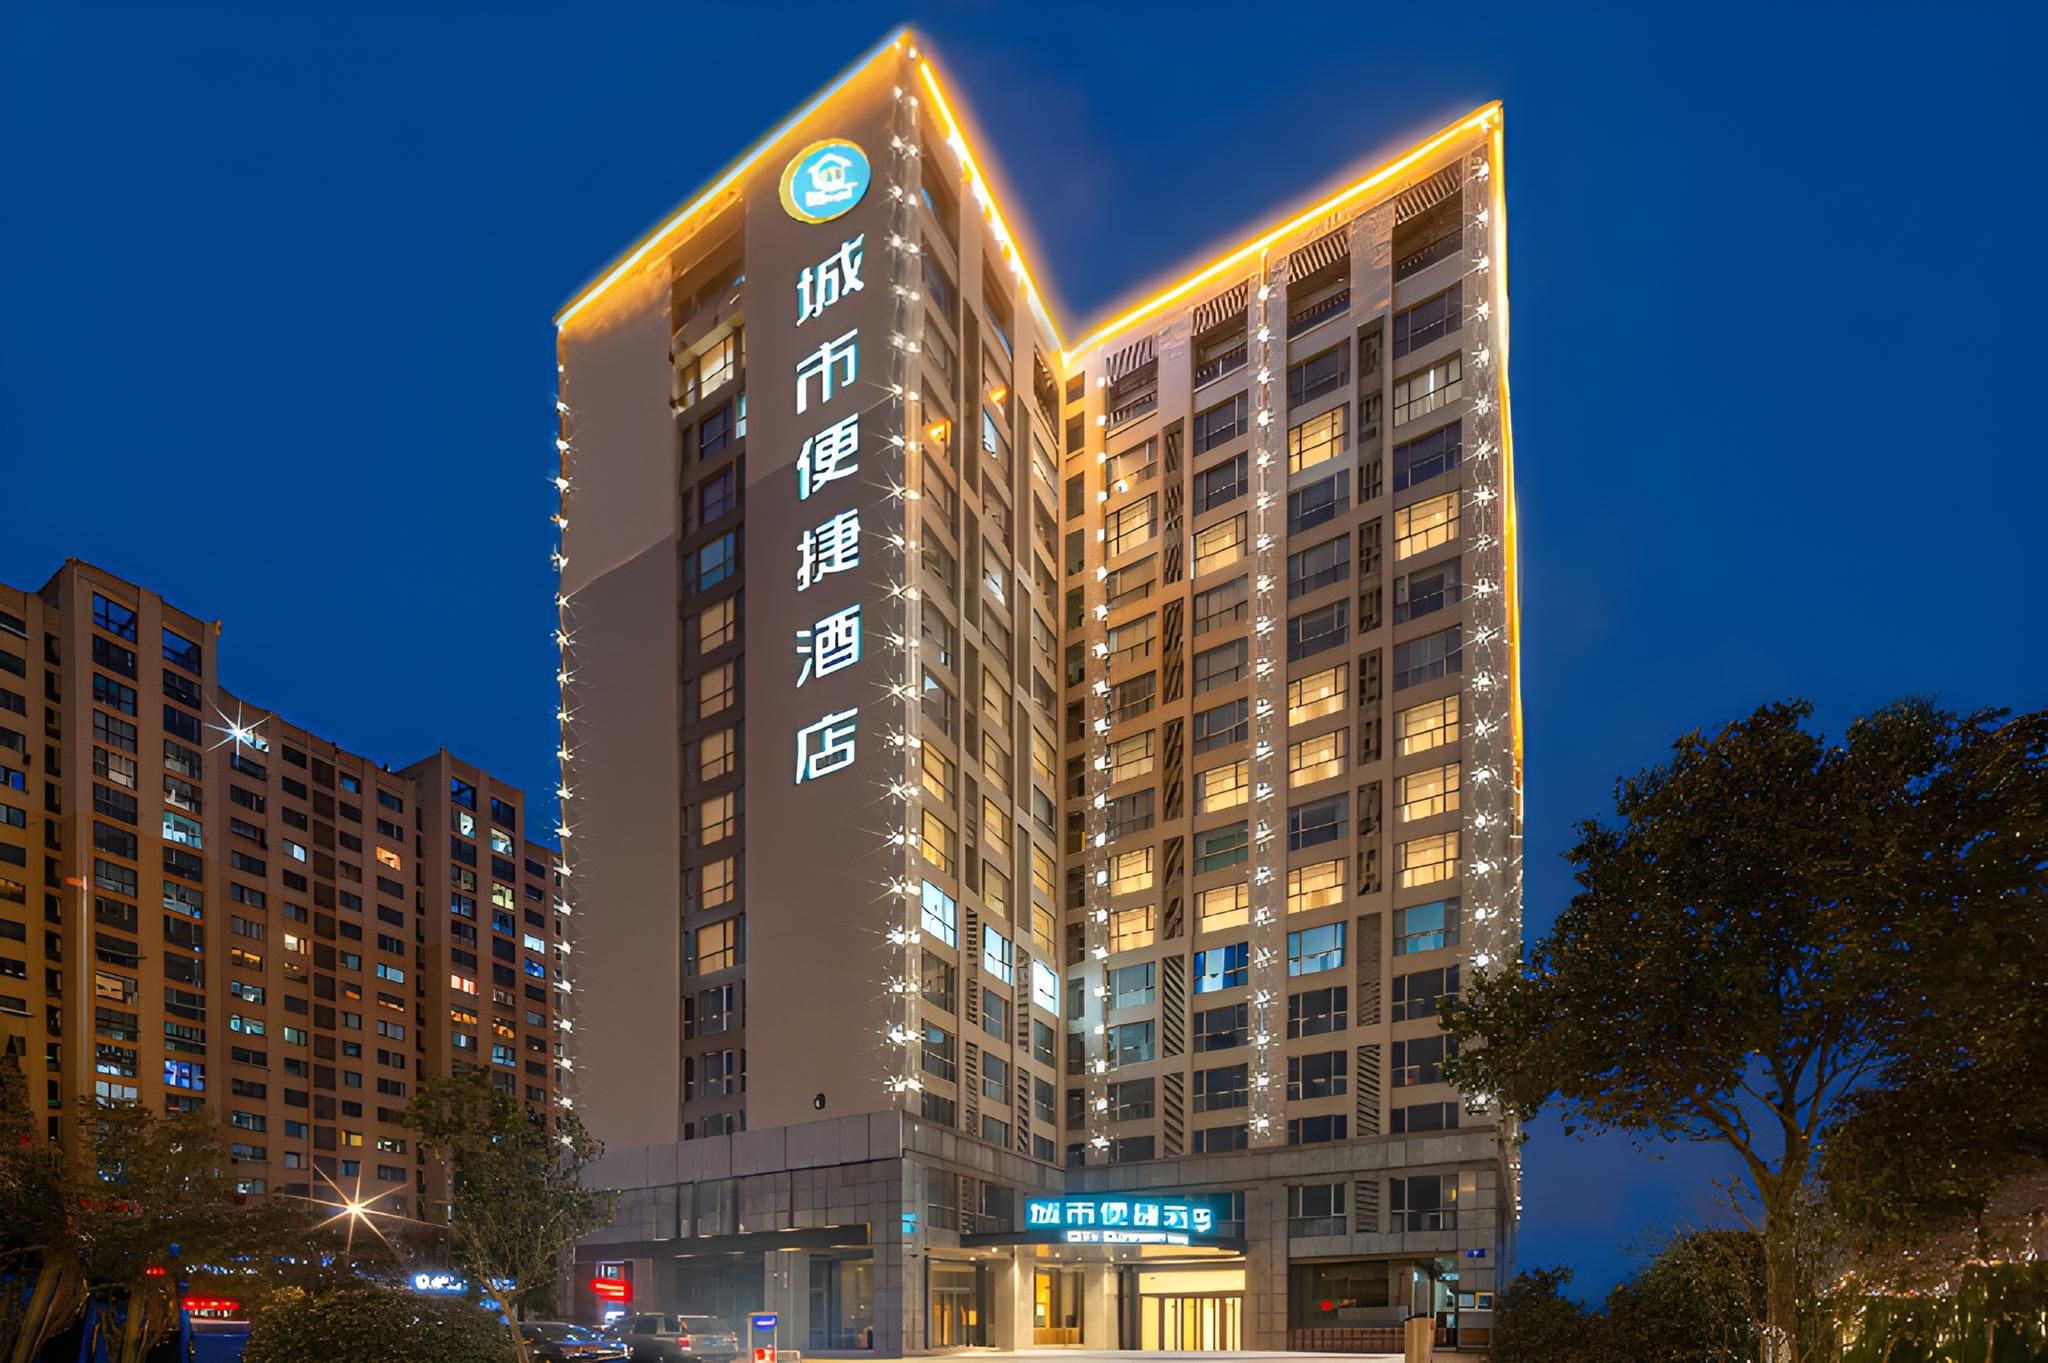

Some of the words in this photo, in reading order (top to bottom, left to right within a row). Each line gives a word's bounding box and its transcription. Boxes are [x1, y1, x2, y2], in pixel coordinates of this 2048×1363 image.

[796, 233, 865, 785] 城市便捷酒店
